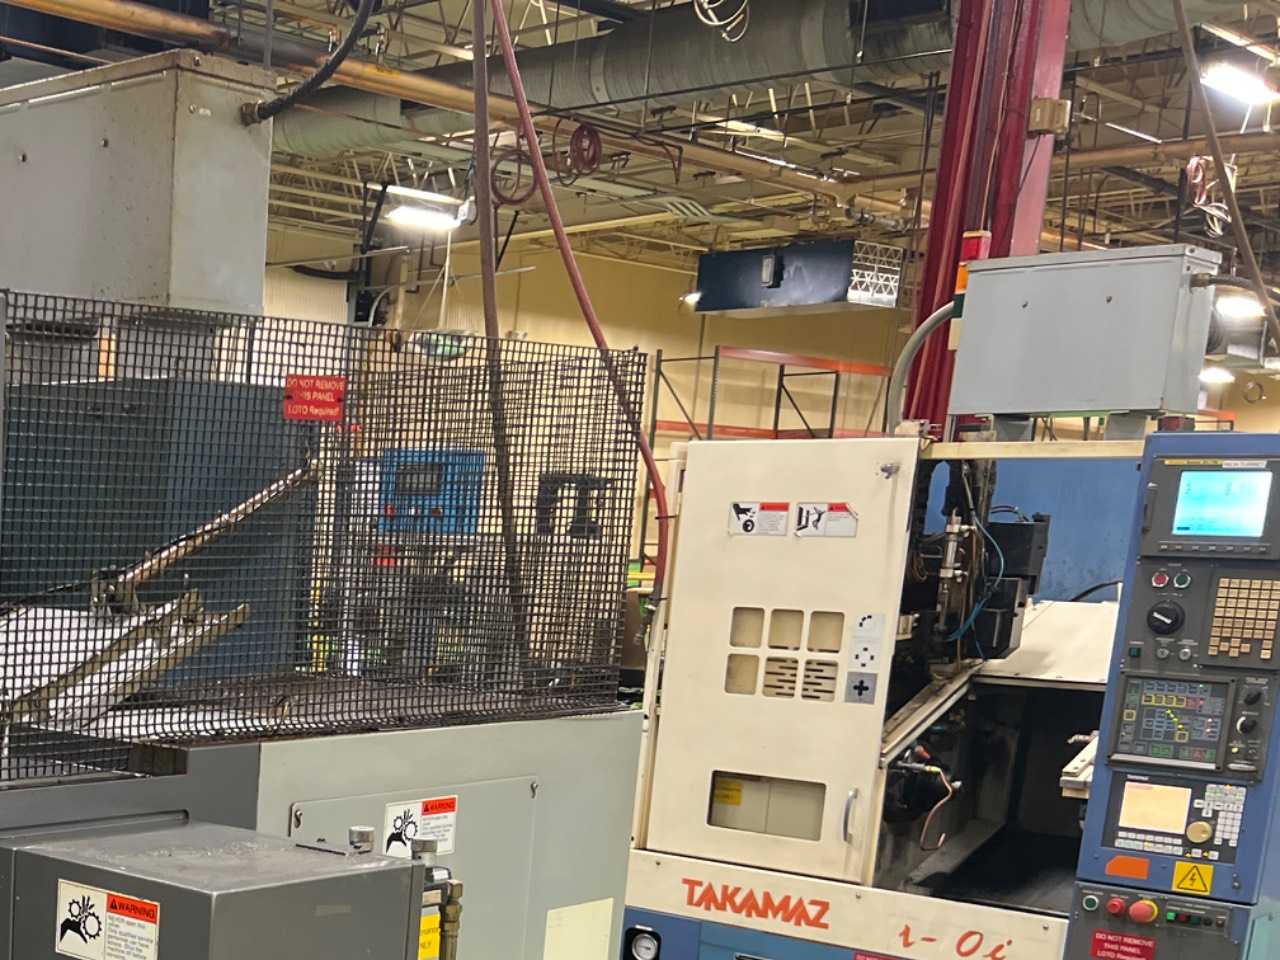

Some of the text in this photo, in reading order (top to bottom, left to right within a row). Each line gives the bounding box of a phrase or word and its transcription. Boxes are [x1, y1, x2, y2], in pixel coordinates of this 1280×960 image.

[287, 377, 345, 391] DO NOT REMOVE
[312, 391, 335, 402] PANEL
[287, 404, 308, 415] LOTO
[118, 902, 155, 919] WARNING
[682, 878, 830, 930] TAKAMAZ
